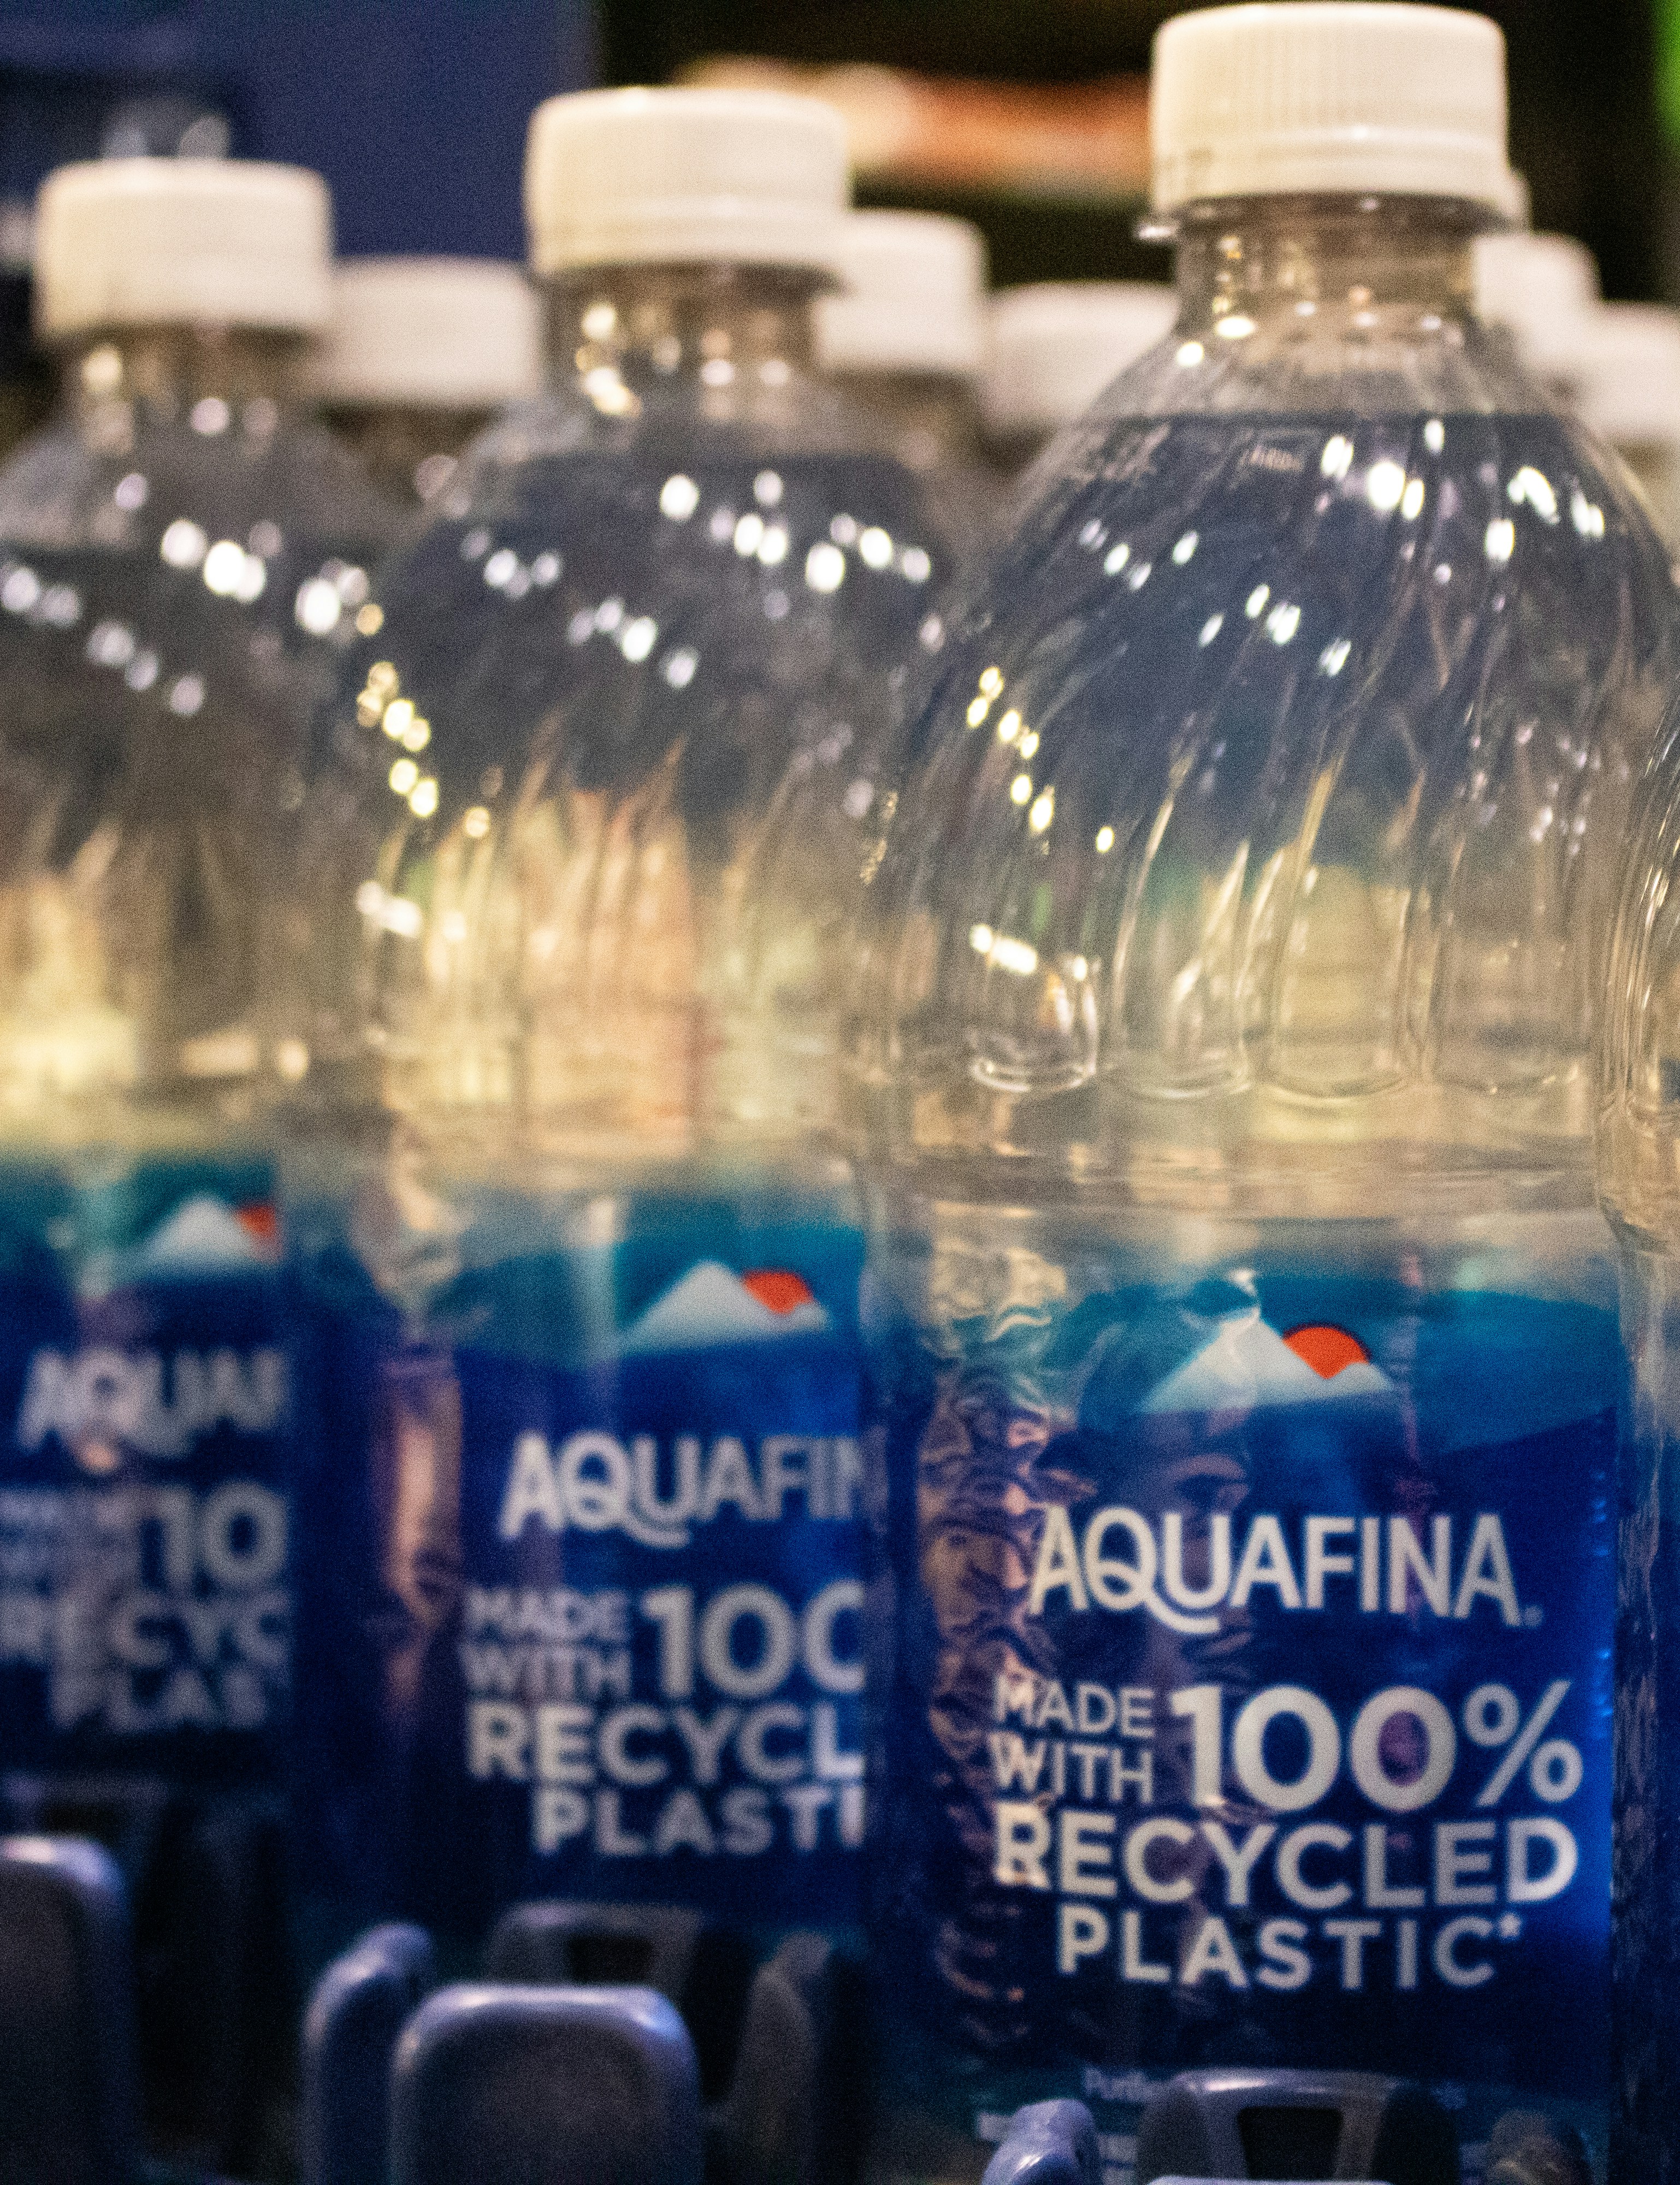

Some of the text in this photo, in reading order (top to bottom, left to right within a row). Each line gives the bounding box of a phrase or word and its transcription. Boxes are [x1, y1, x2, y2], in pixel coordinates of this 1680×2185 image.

[992, 1671, 1155, 1739] MADE
[1170, 1680, 1585, 1812] 100%
[989, 1733, 1153, 1804] WITH
[992, 1802, 1579, 1909] RECYCLED
